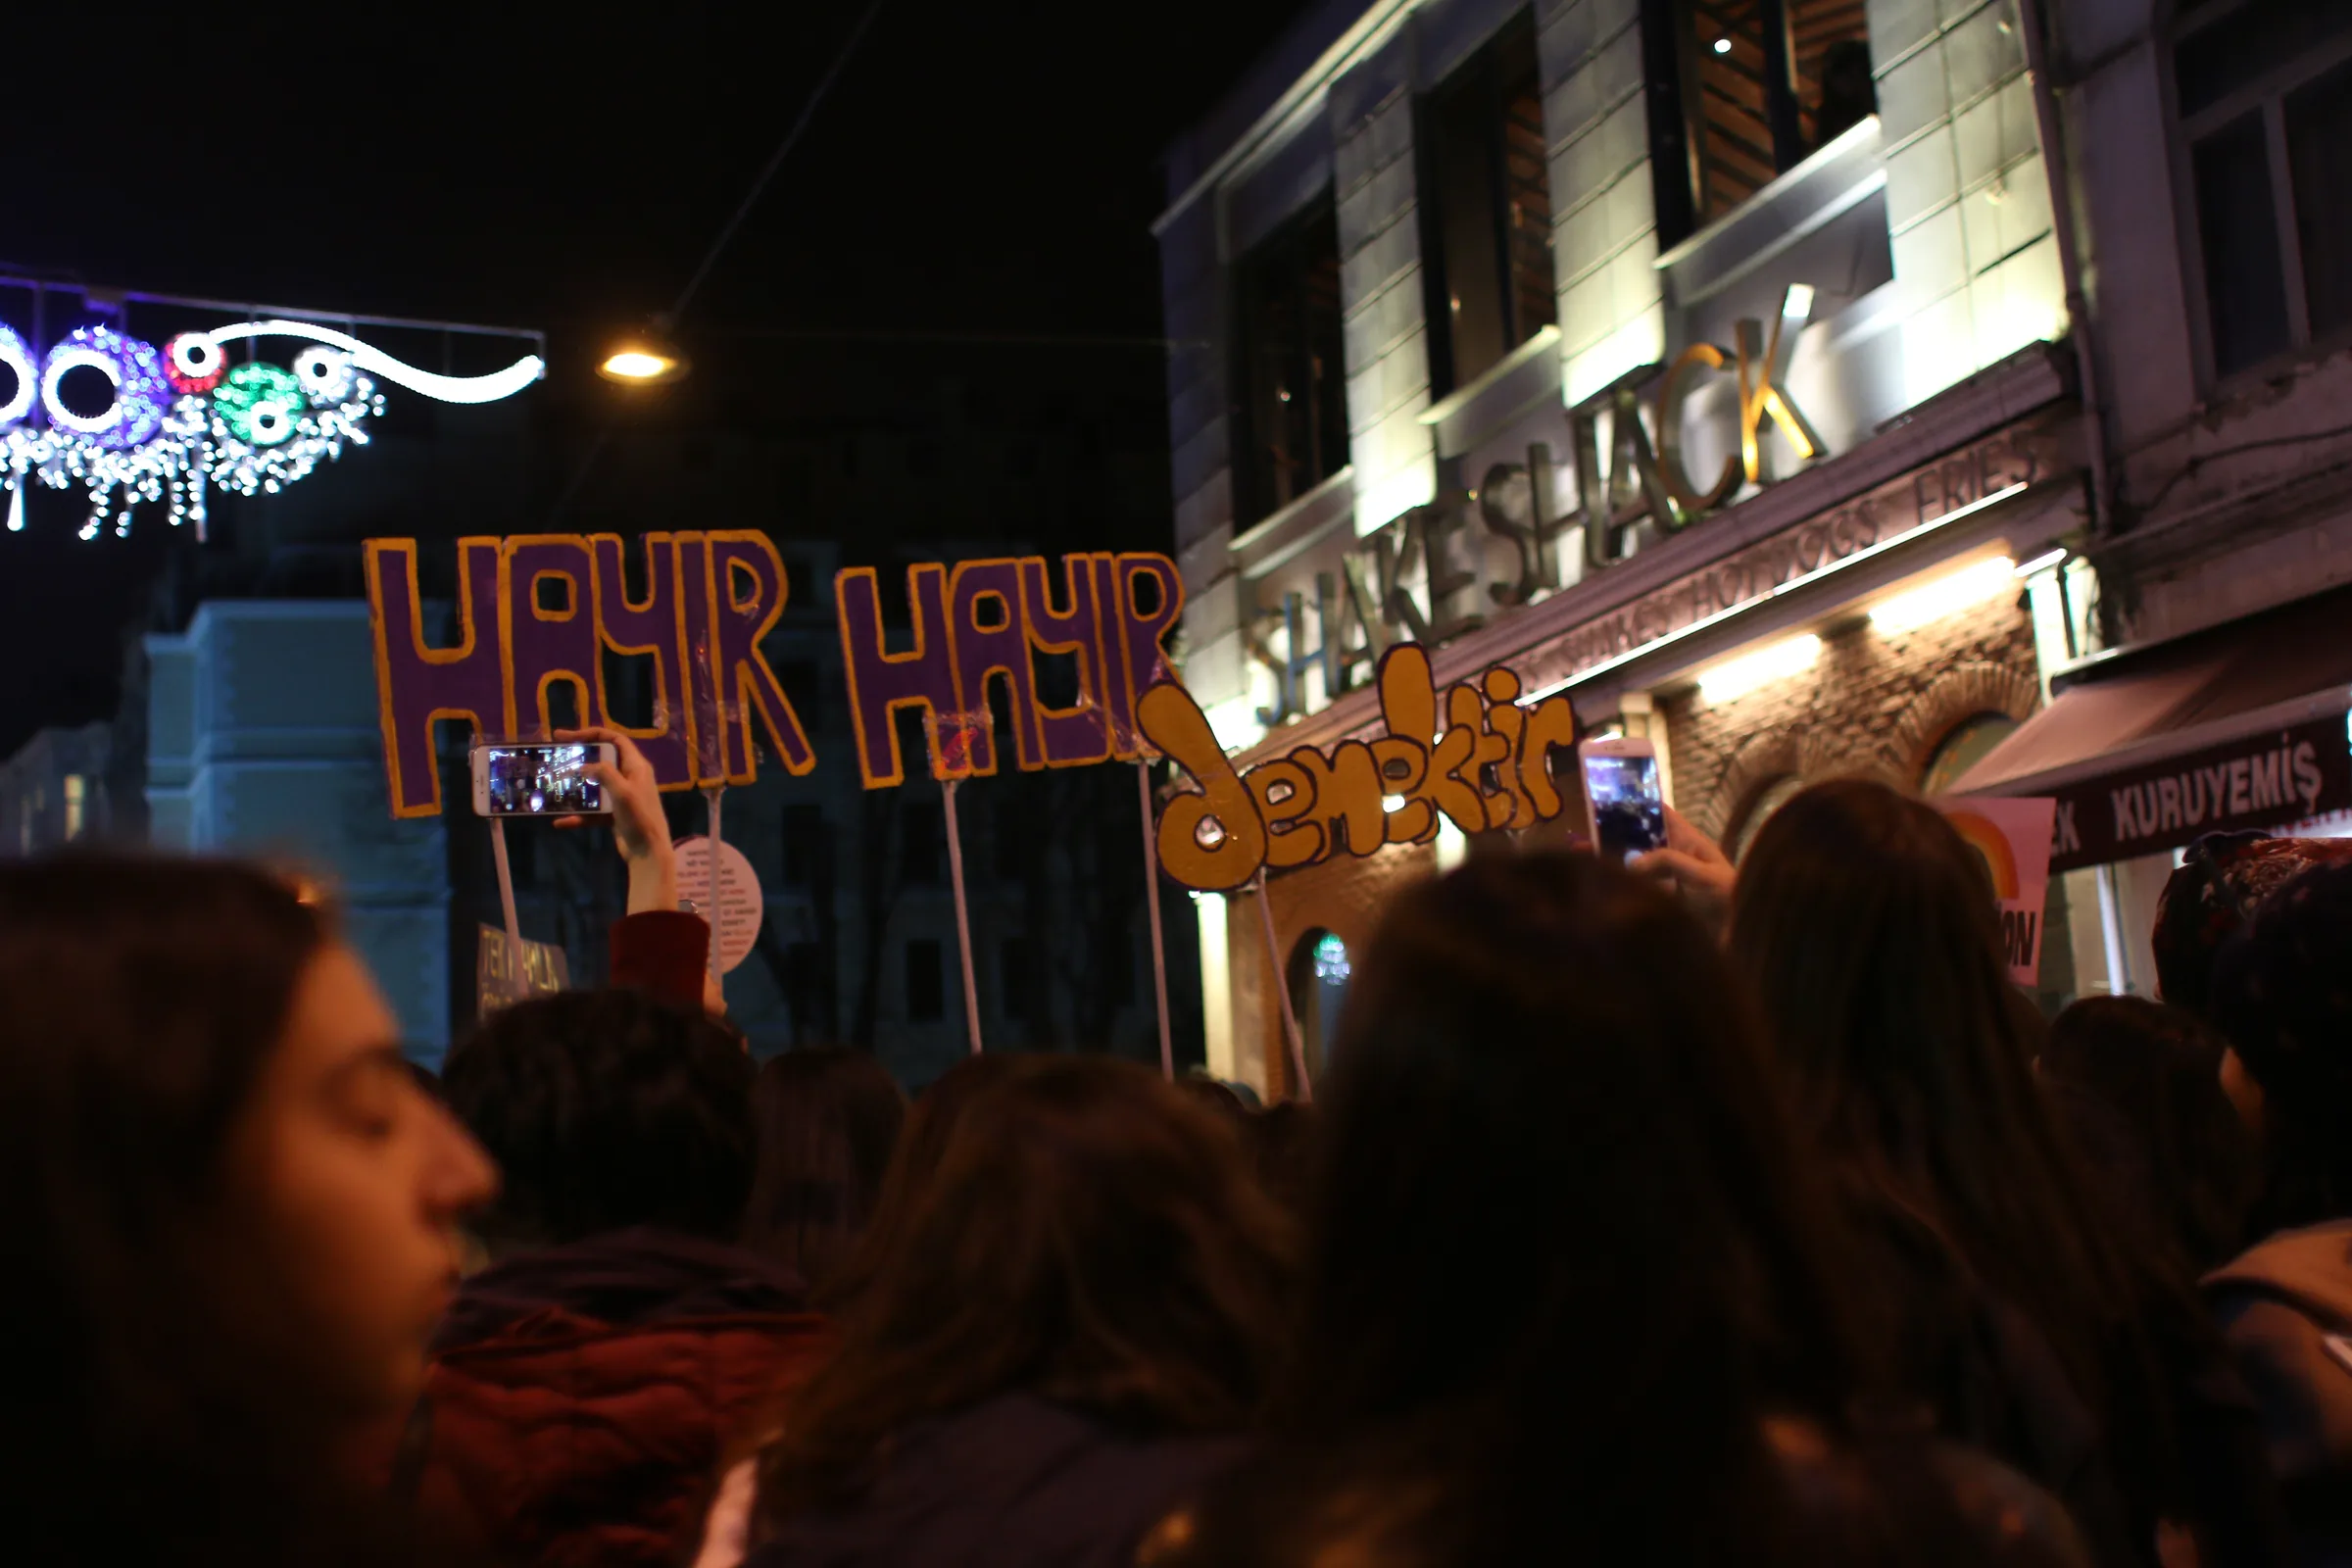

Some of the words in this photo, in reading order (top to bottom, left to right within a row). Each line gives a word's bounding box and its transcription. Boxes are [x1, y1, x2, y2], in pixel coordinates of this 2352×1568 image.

[1913, 429, 2041, 521] FRIES
[363, 529, 816, 817] HAYIR
[835, 551, 1183, 789] HAYIR
[2111, 733, 2323, 843] KURUYEMİŞ
